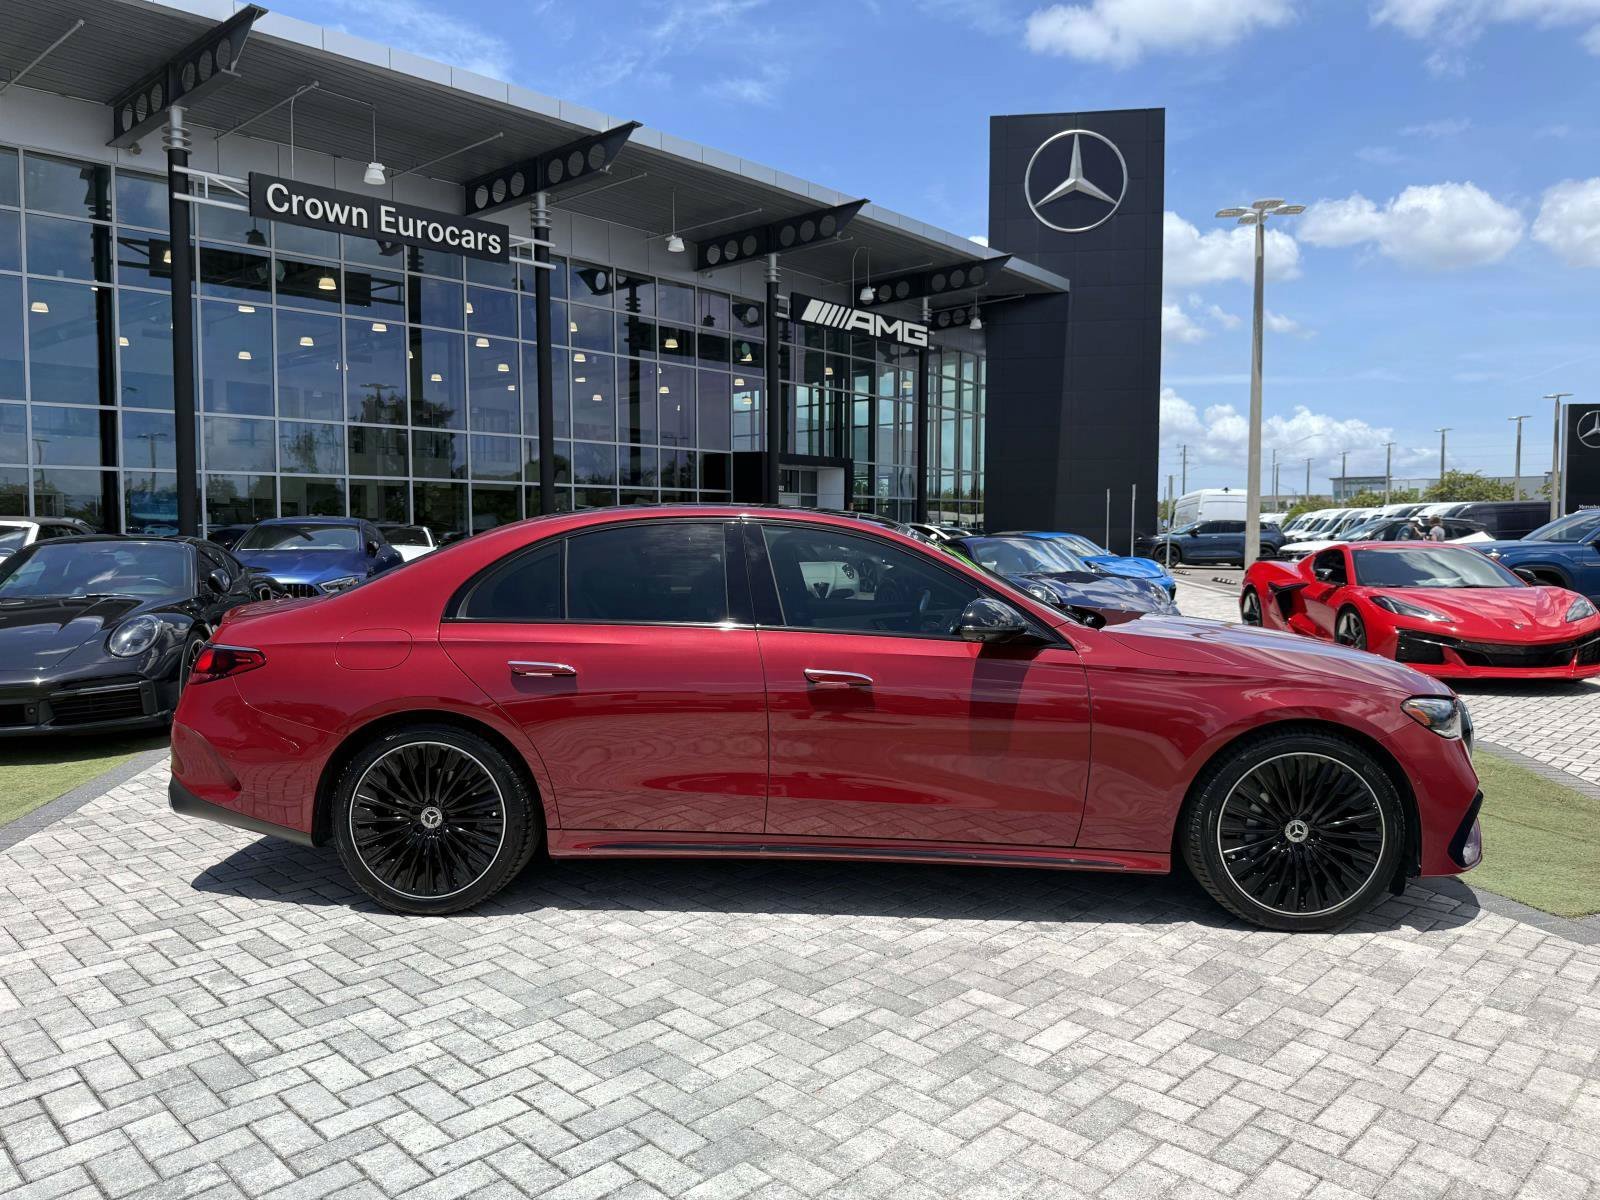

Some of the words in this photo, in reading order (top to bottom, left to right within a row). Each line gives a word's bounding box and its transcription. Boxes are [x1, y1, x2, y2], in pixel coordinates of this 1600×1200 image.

[266, 183, 368, 229] Crown
[380, 205, 501, 254] Eurocars
[844, 309, 928, 347] AMG
